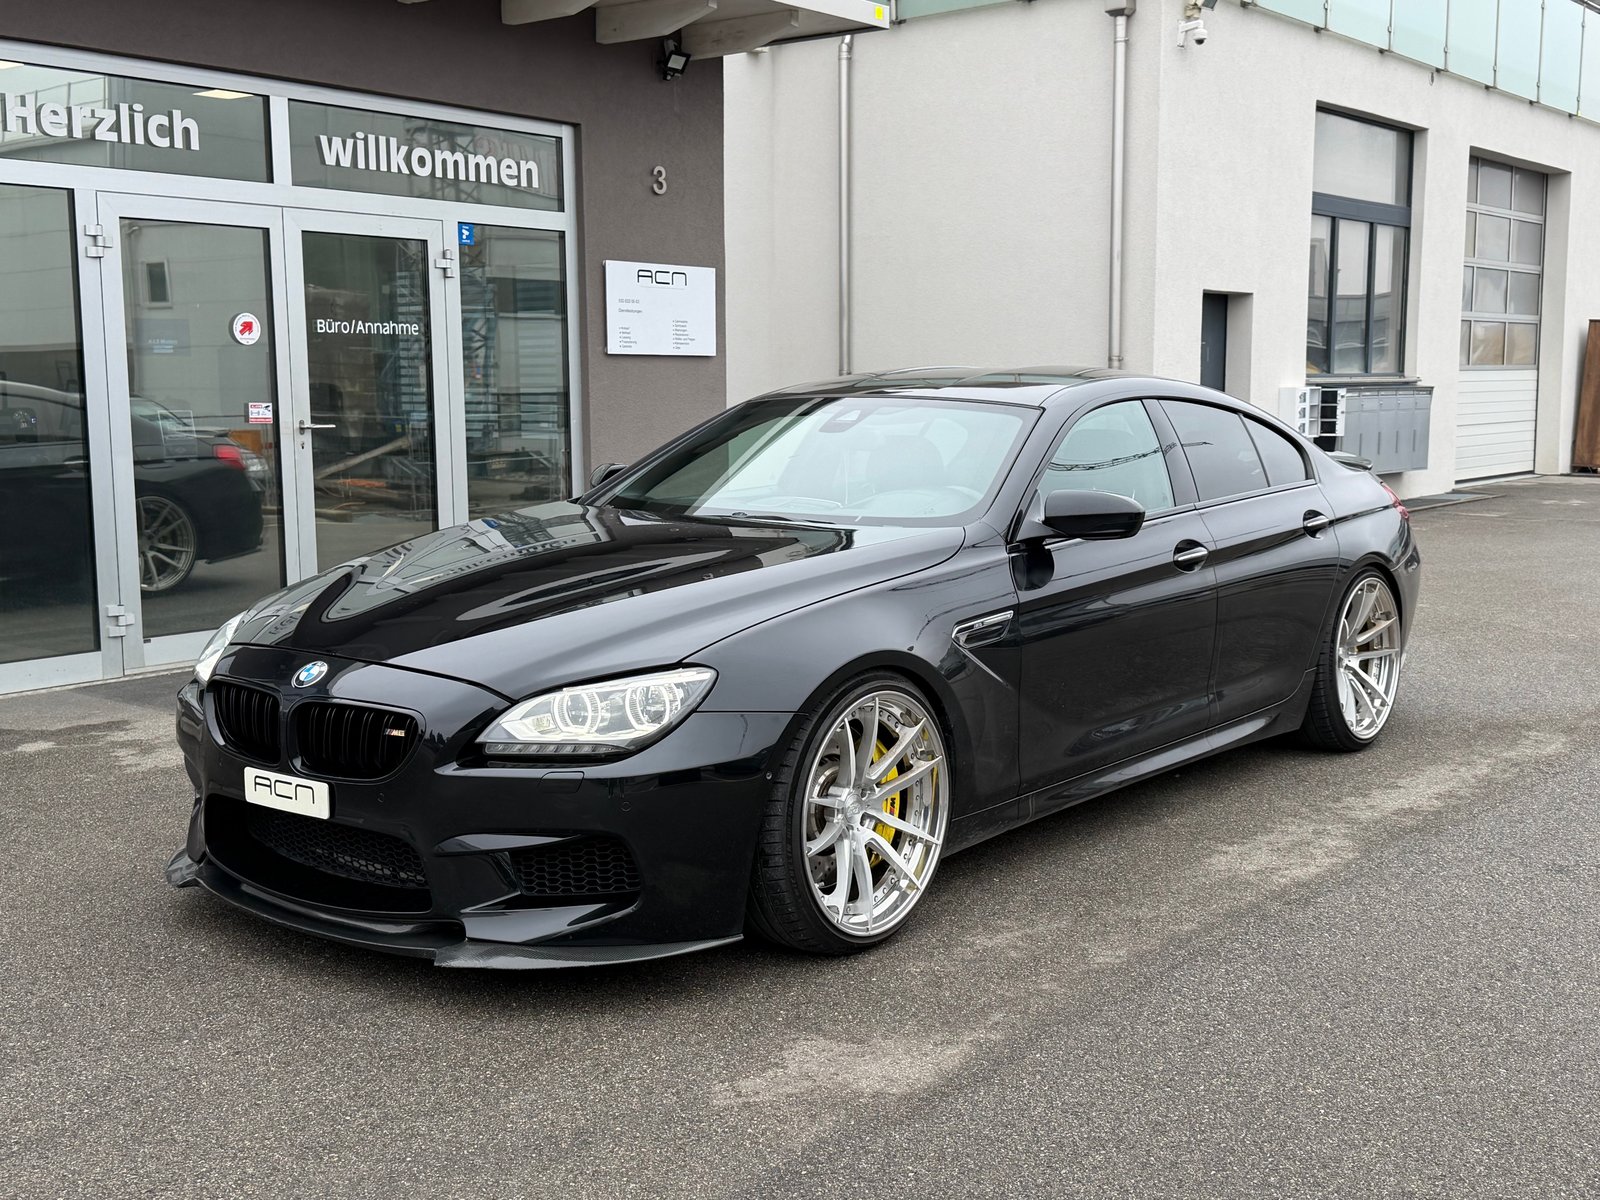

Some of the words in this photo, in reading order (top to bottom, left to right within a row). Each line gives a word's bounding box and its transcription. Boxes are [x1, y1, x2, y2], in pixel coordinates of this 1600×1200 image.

[3, 92, 200, 151] Herzlich
[319, 131, 539, 188] willkommen
[652, 165, 667, 195] 3
[316, 319, 420, 336] Büro/Annahme
[254, 775, 314, 804] ACN
